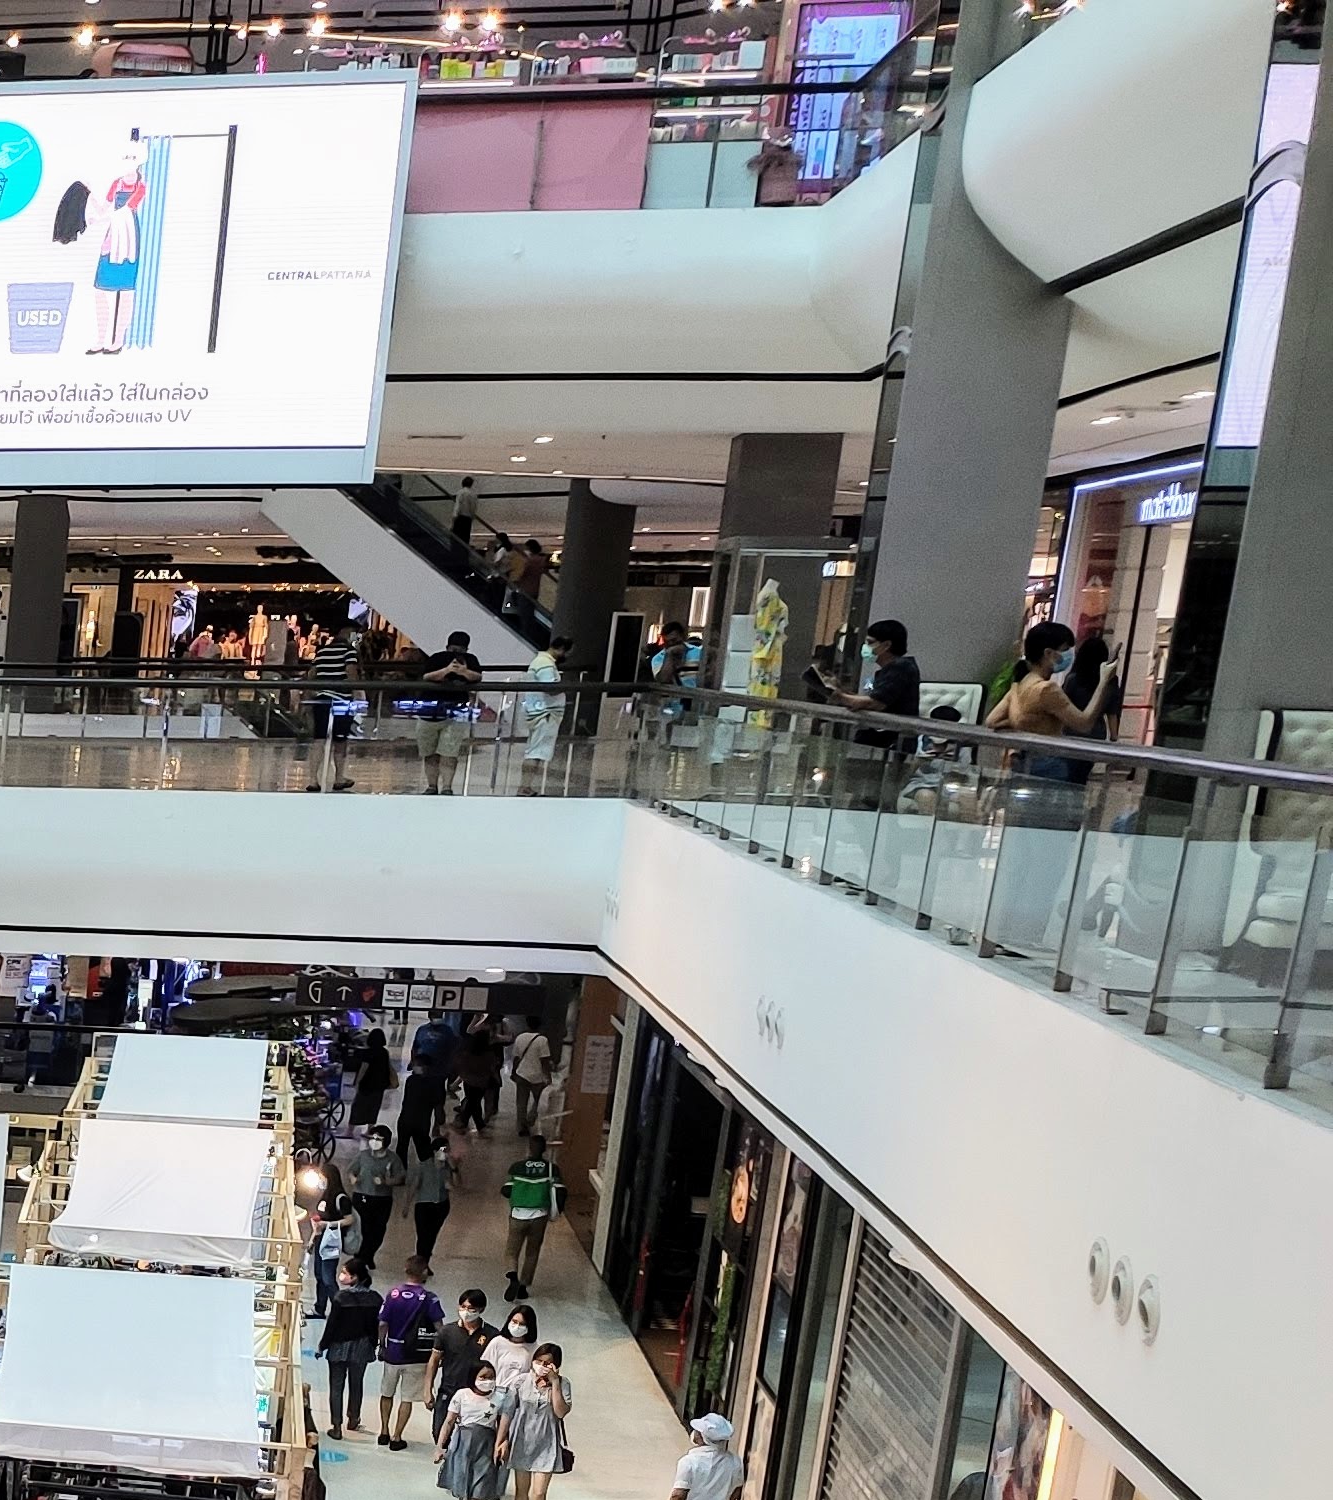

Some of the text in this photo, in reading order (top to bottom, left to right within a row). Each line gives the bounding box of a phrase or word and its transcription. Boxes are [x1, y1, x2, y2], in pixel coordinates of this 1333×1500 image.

[16, 310, 62, 327] USED
[119, 382, 209, 402] ใส่ในกล่อง
[167, 408, 192, 423] UV
[134, 569, 183, 580] ZARA
[308, 980, 323, 1004] G
[441, 990, 457, 1006] P
